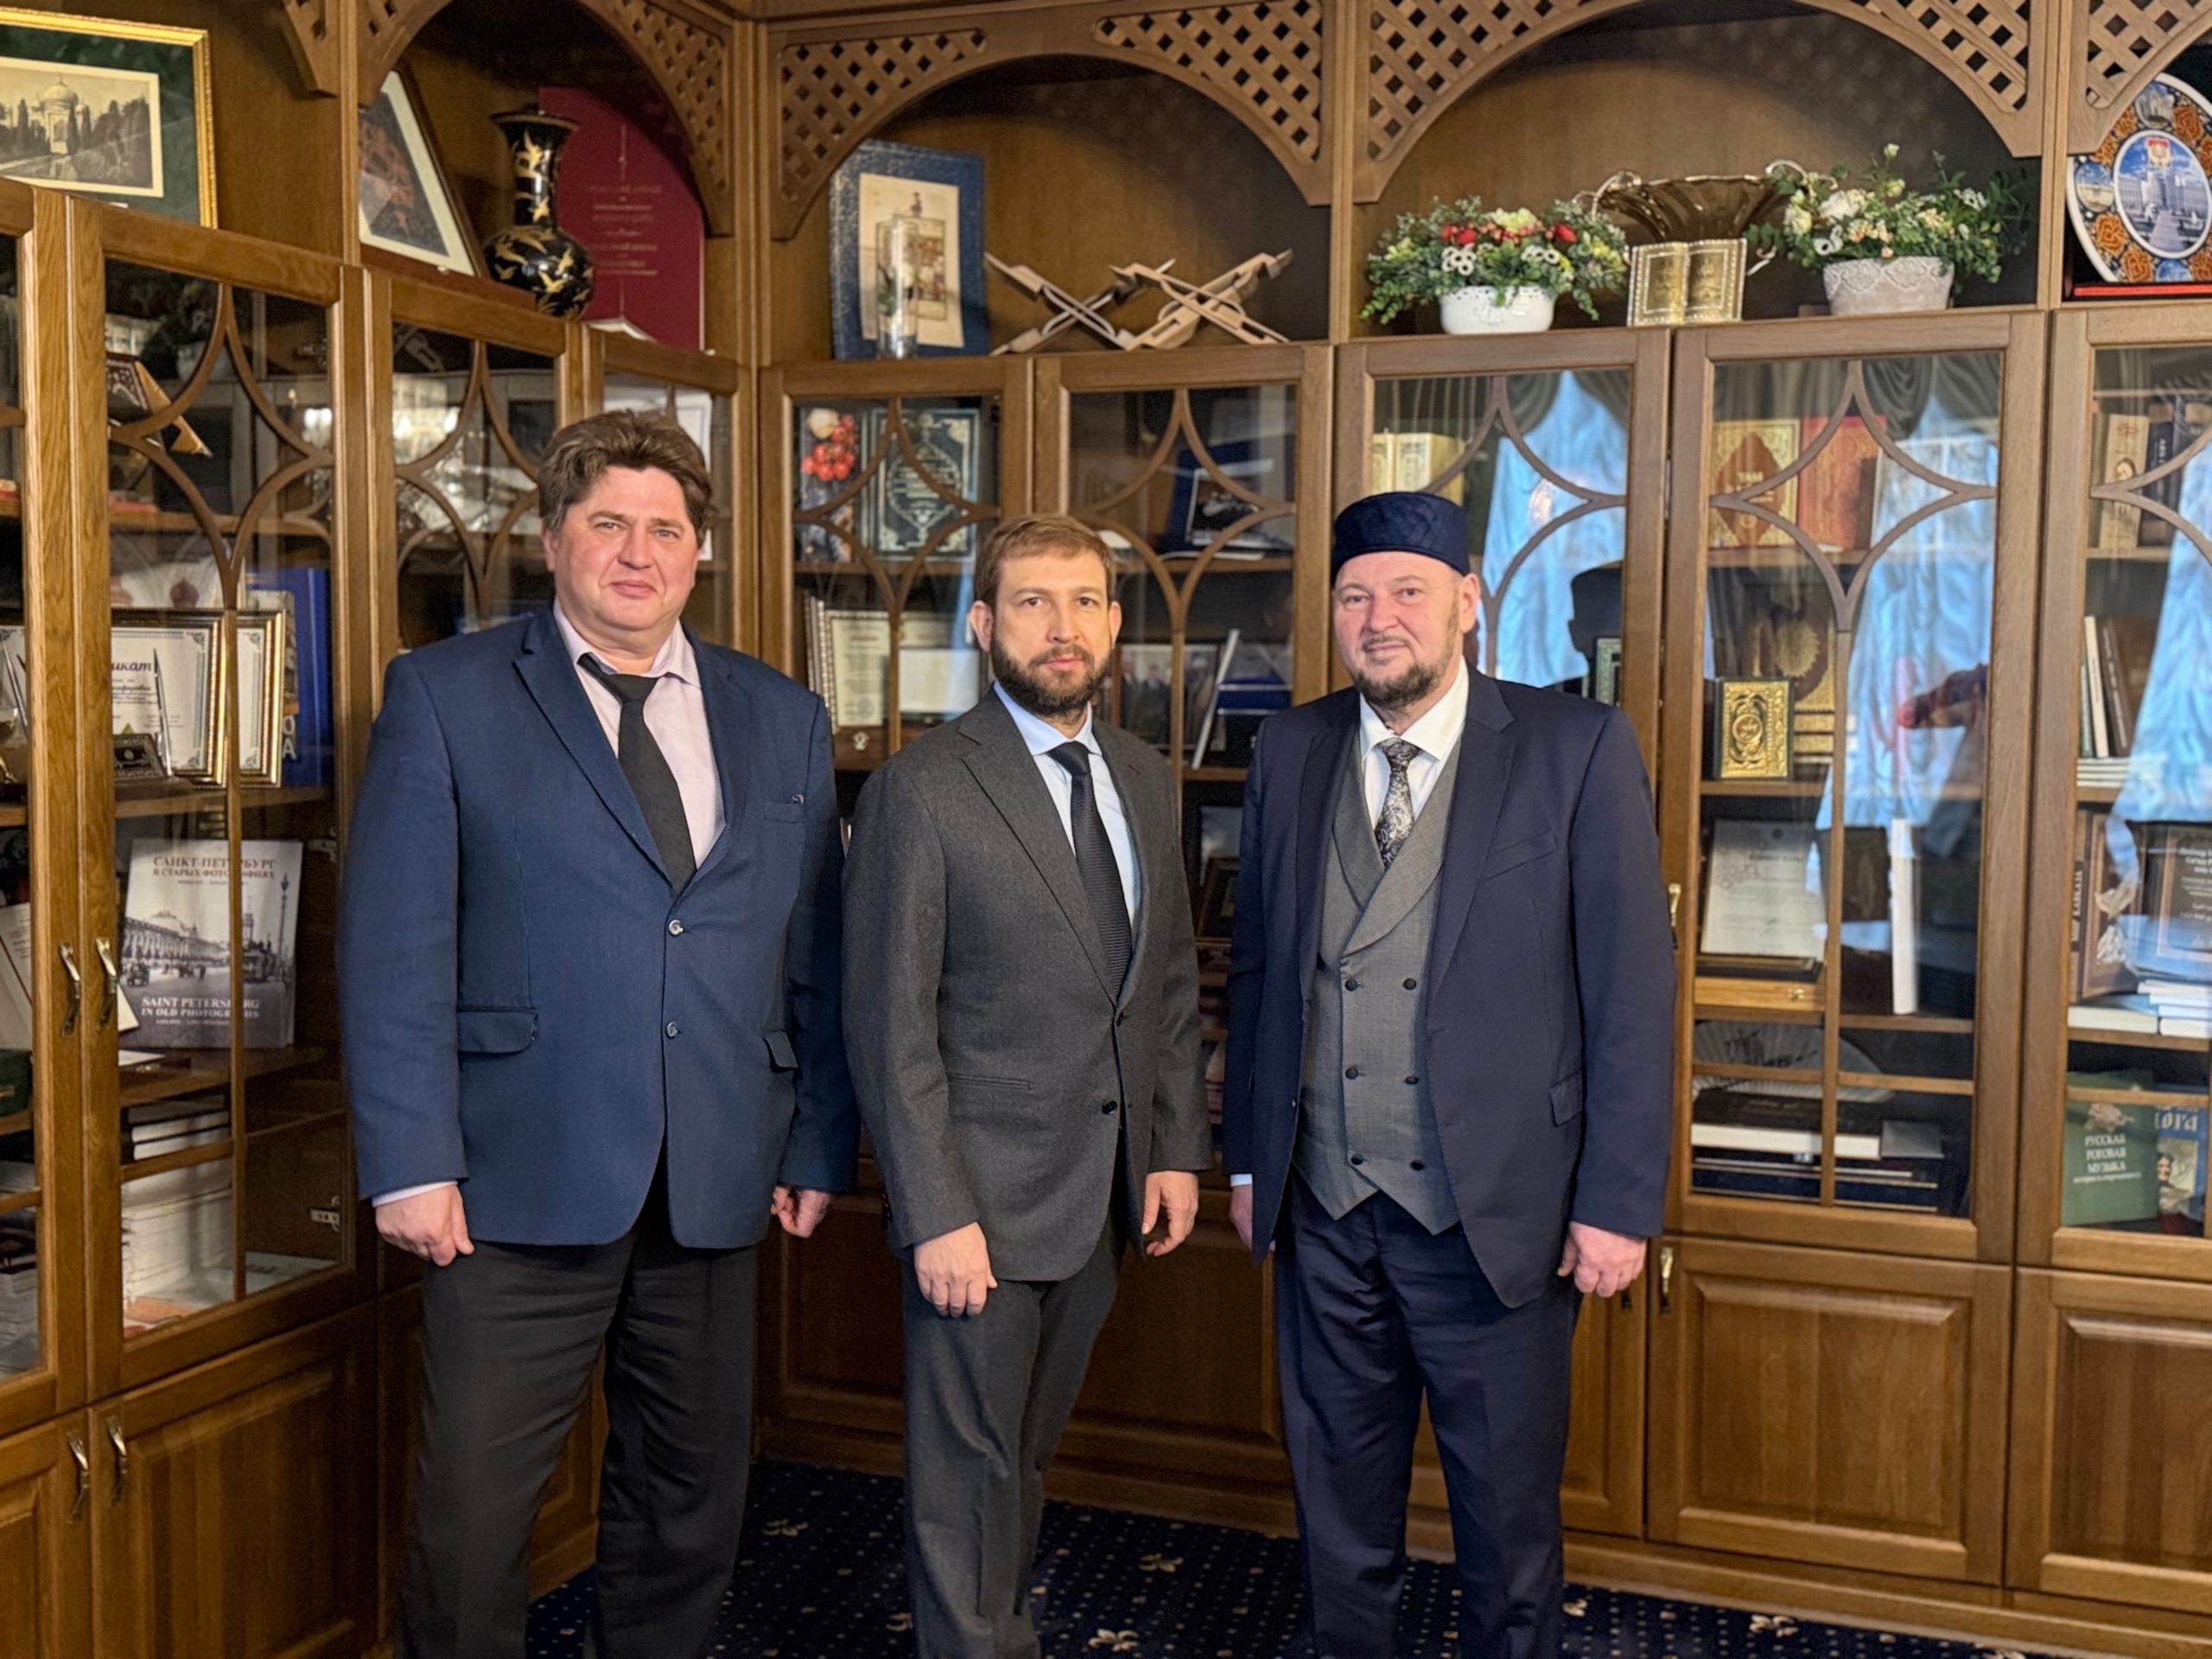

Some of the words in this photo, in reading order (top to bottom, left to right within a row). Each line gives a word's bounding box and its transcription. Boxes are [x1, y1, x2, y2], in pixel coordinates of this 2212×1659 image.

[153, 856, 277, 869] САНКТ-ПЕТБУРГ
[162, 868, 200, 878] СТАРЫХ
[201, 868, 275, 879] ФОТОАФИЯХ
[141, 996, 179, 1008] SAINT
[181, 997, 260, 1009] PETERSRG
[141, 1007, 153, 1016] IN
[155, 1007, 178, 1018] OLD
[180, 1008, 259, 1019] PHOTOGRHS
[2084, 1134, 2126, 1147] РУССКАЯ
[2086, 1147, 2126, 1160] РОГОВАЯ
[2087, 1160, 2126, 1174] МУЗЫКА
